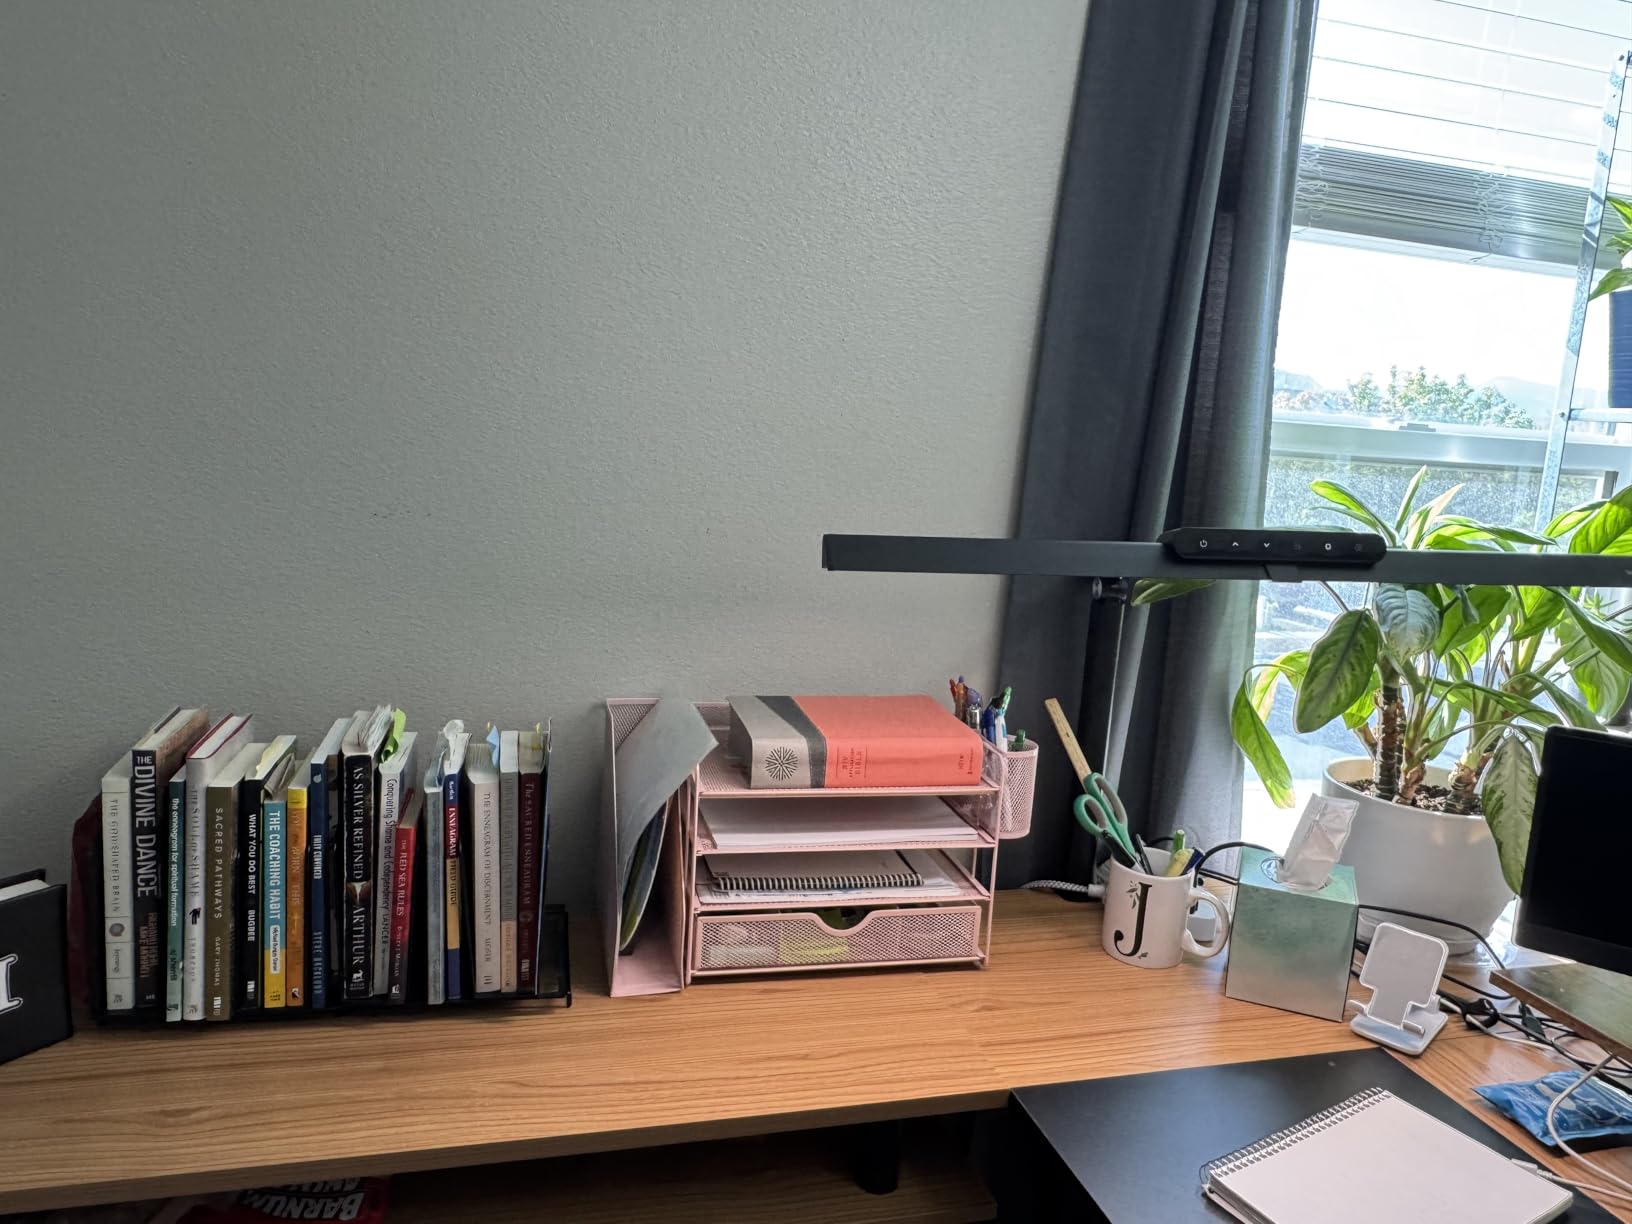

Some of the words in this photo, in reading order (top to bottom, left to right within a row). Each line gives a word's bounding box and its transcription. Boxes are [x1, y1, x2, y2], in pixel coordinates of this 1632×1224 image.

[137, 756, 152, 765] THE
[353, 767, 363, 779] AS
[135, 766, 155, 827] DIVINE
[353, 783, 364, 824] SILVER
[384, 779, 397, 818] Conquering
[525, 783, 534, 798] The
[110, 800, 119, 817] THE
[269, 811, 280, 831] THE
[215, 808, 223, 853] SACRED
[385, 821, 395, 843] Shame
[136, 835, 157, 897] DANCE
[171, 852, 179, 862] for
[249, 860, 256, 872] DO
[269, 834, 280, 886] COACHING
[353, 828, 363, 879] REFINED
[384, 846, 394, 858] and
[399, 852, 407, 870] RED
[170, 864, 179, 891] spiritual
[214, 859, 223, 919] PATHWAYS
[248, 875, 256, 894] BEST
[381, 861, 394, 909] Codependency
[112, 886, 121, 912] BRAIN
[171, 892, 179, 926] formation
[270, 889, 280, 919] HABIT
[396, 890, 405, 916] RULES
[483, 872, 492, 925] DISCERNMENT
[247, 910, 255, 941] BUGBEE
[1114, 882, 1153, 957] J
[313, 932, 322, 953] STEVE
[352, 905, 365, 965] ARTHUR
